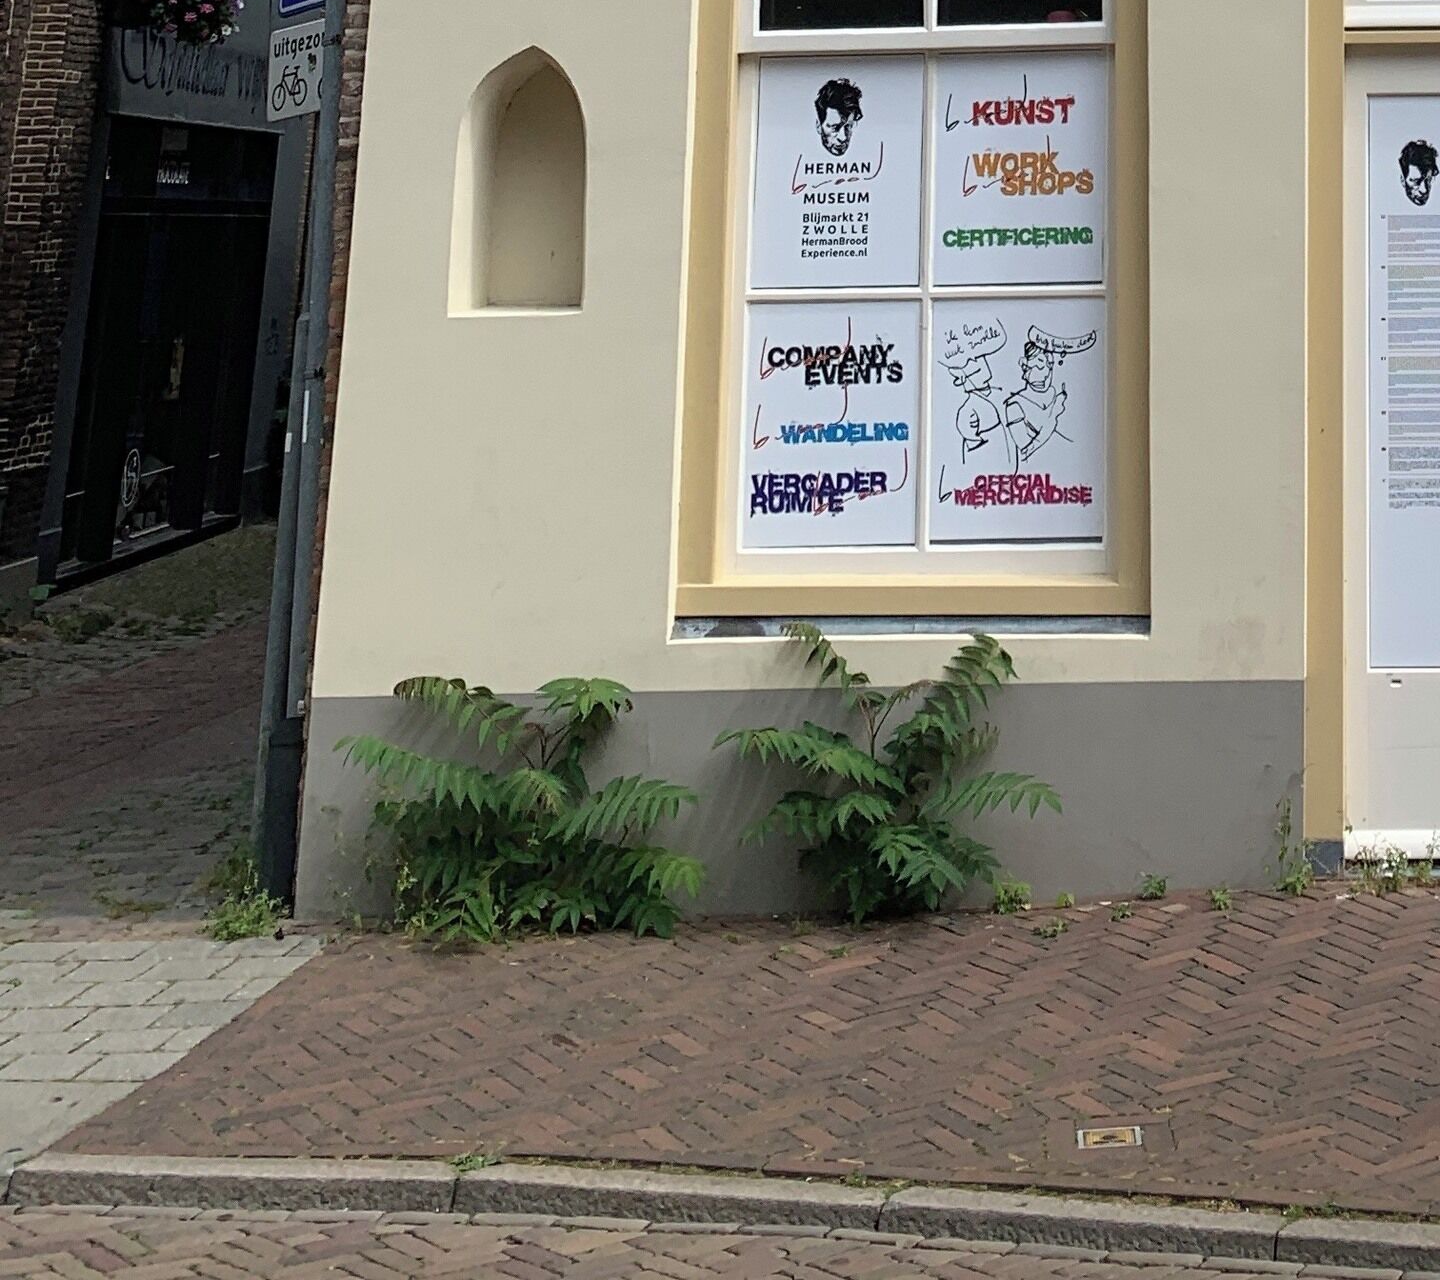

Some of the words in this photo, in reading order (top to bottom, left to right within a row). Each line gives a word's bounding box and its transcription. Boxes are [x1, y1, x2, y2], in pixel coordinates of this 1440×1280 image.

[972, 96, 1075, 126] KUNST
[804, 162, 871, 174] HERMAN
[972, 150, 1059, 178] WORK
[1000, 169, 1094, 196] SHOPS
[803, 192, 870, 204] MUSEUM
[802, 211, 854, 224] Blijmarkt
[857, 212, 869, 222] 21
[801, 236, 868, 246] HermanBrood
[942, 226, 1094, 249] CERTIFICERING
[801, 248, 868, 259] Experience.nl
[767, 343, 896, 369] COMPANY
[805, 362, 903, 387] EVENTS
[780, 422, 910, 444] WANDELING
[974, 472, 1053, 491] OFFICIAL
[954, 485, 1093, 507] MERCHANDISE
